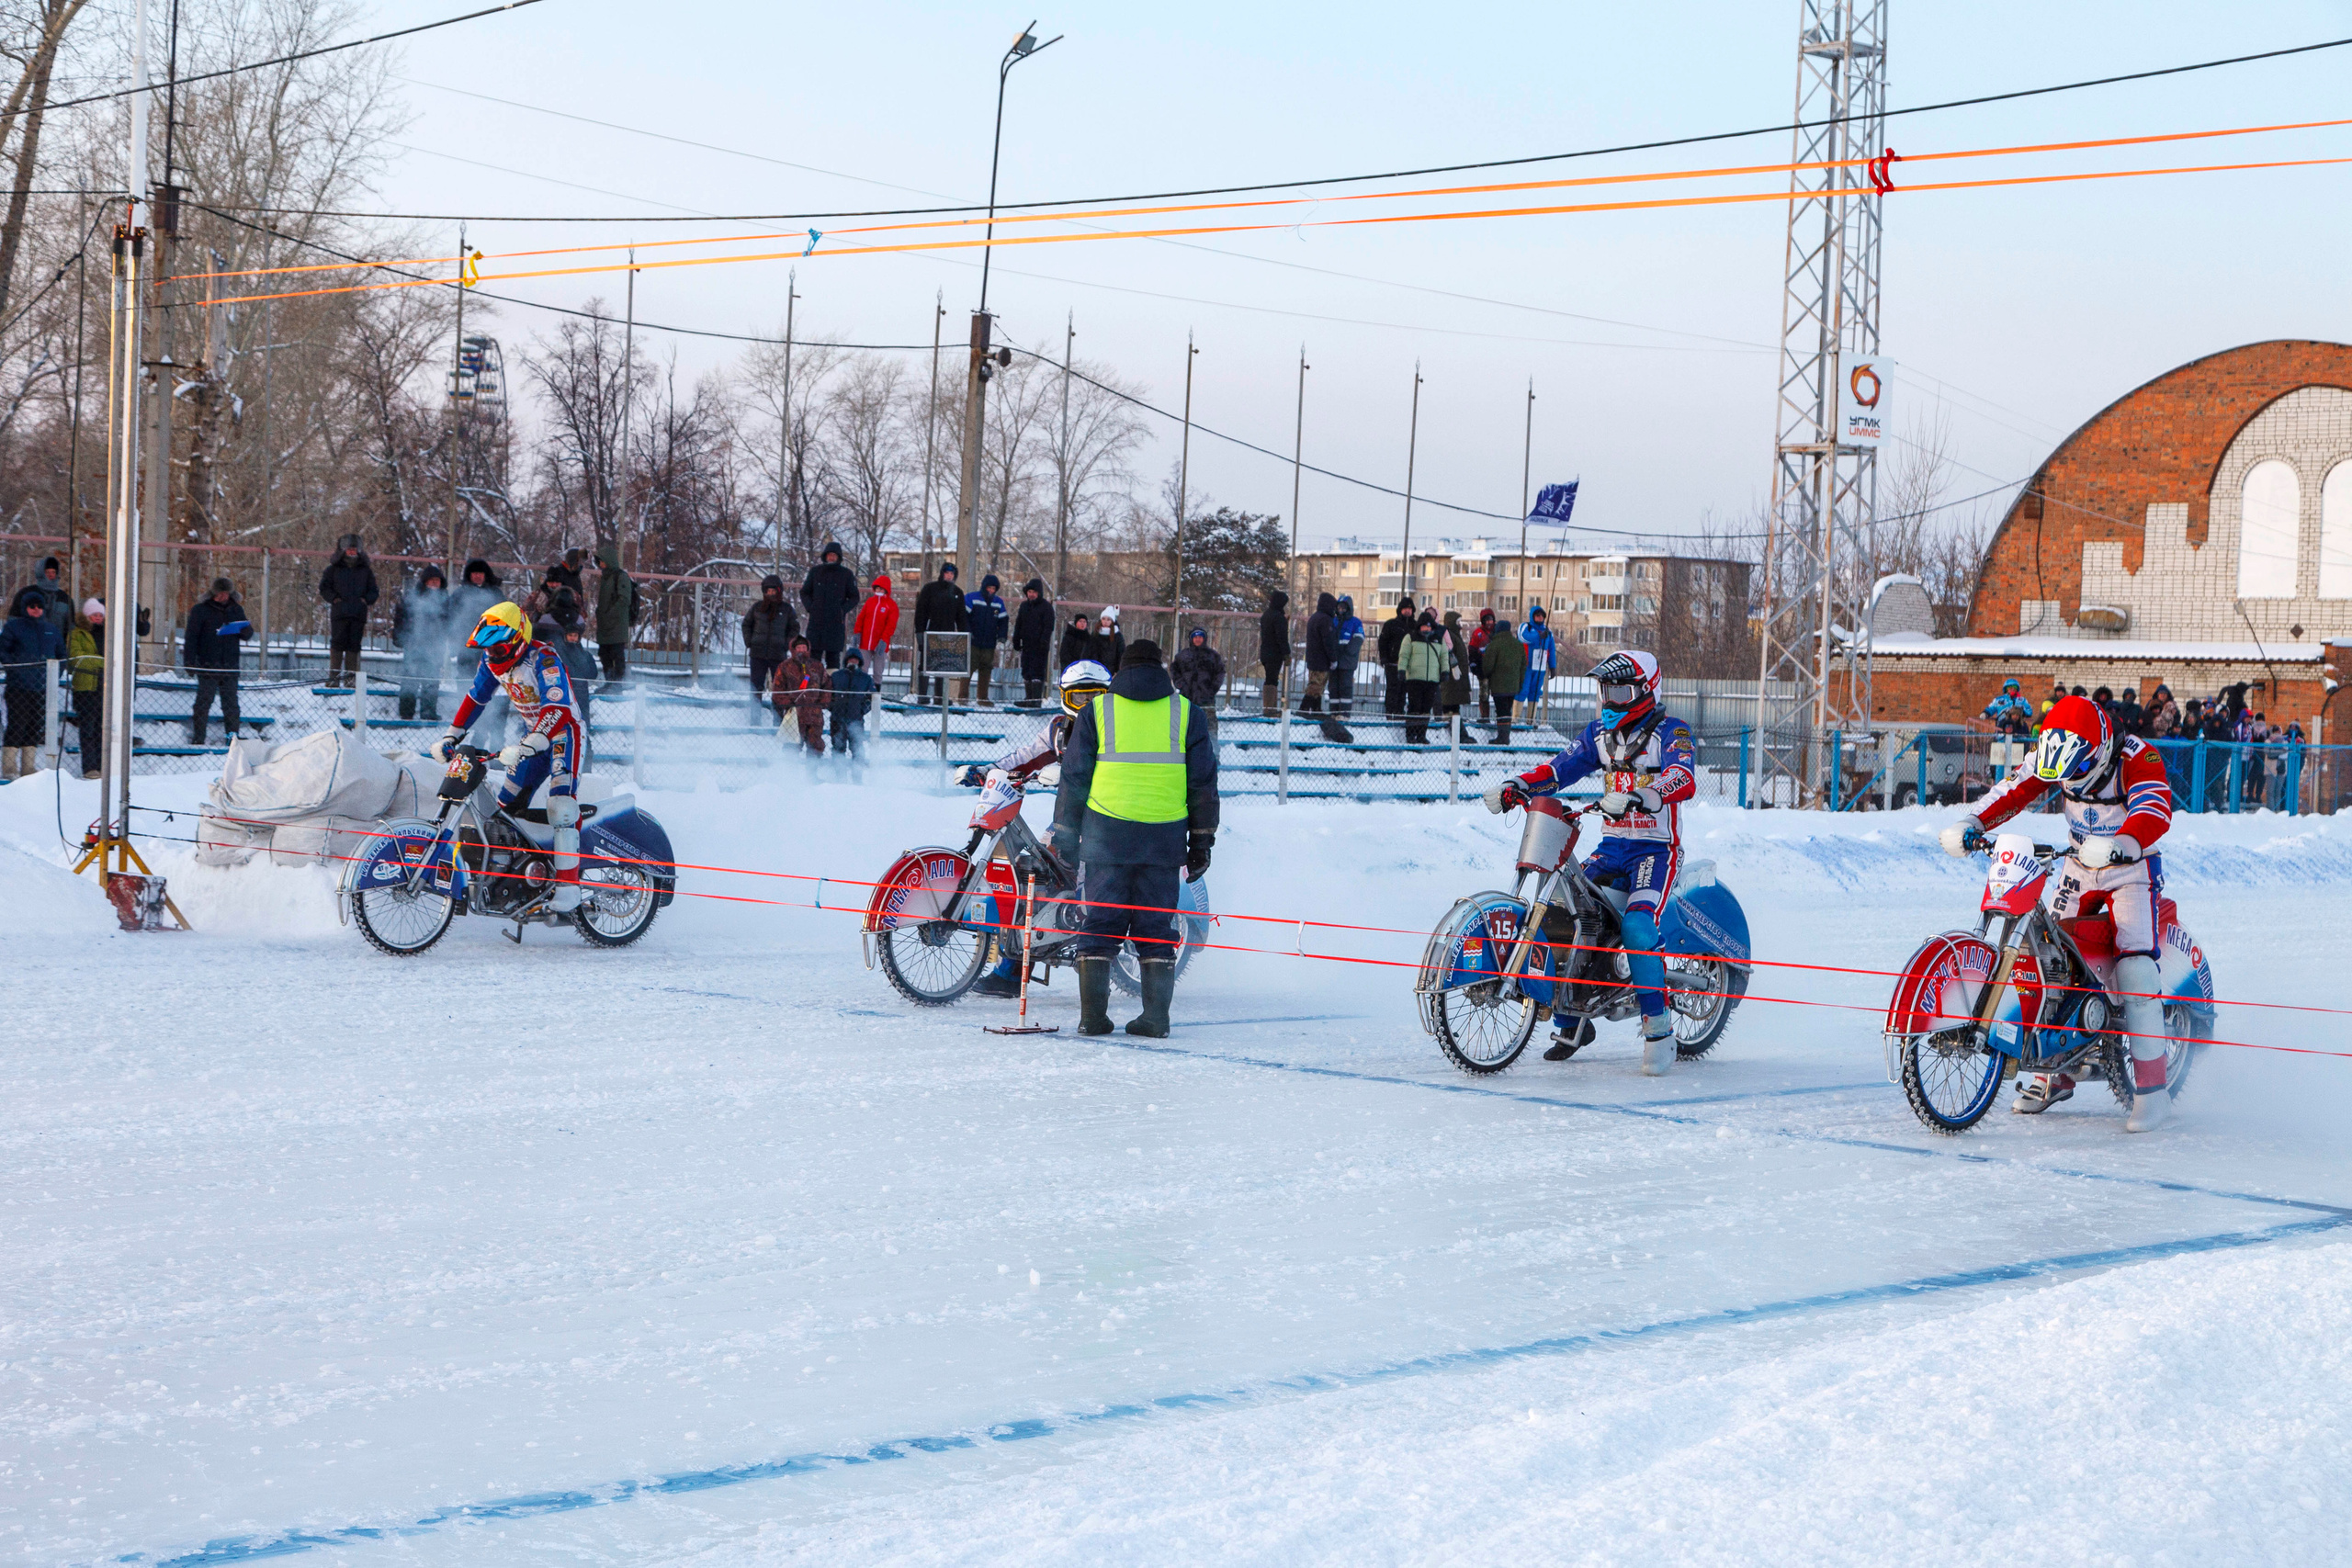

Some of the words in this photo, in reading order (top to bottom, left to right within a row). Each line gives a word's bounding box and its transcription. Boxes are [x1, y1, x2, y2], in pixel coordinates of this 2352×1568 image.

[1849, 415, 1881, 428] УГМК
[1849, 426, 1881, 438] UMMC
[995, 781, 1016, 801] LADA
[1657, 773, 1690, 797] KUMZ
[2014, 853, 2040, 876] LADA
[881, 881, 910, 929] MEGA
[923, 858, 956, 881] LADA
[1495, 919, 1511, 940] 15
[1676, 896, 1723, 939] МИНИСТЕРСТВО
[1722, 933, 1746, 958] СПОРТА
[1962, 946, 1992, 976] LADA
[2165, 923, 2192, 957] MEGA
[2197, 960, 2213, 1010] LADA
[2022, 971, 2037, 982] LADA
